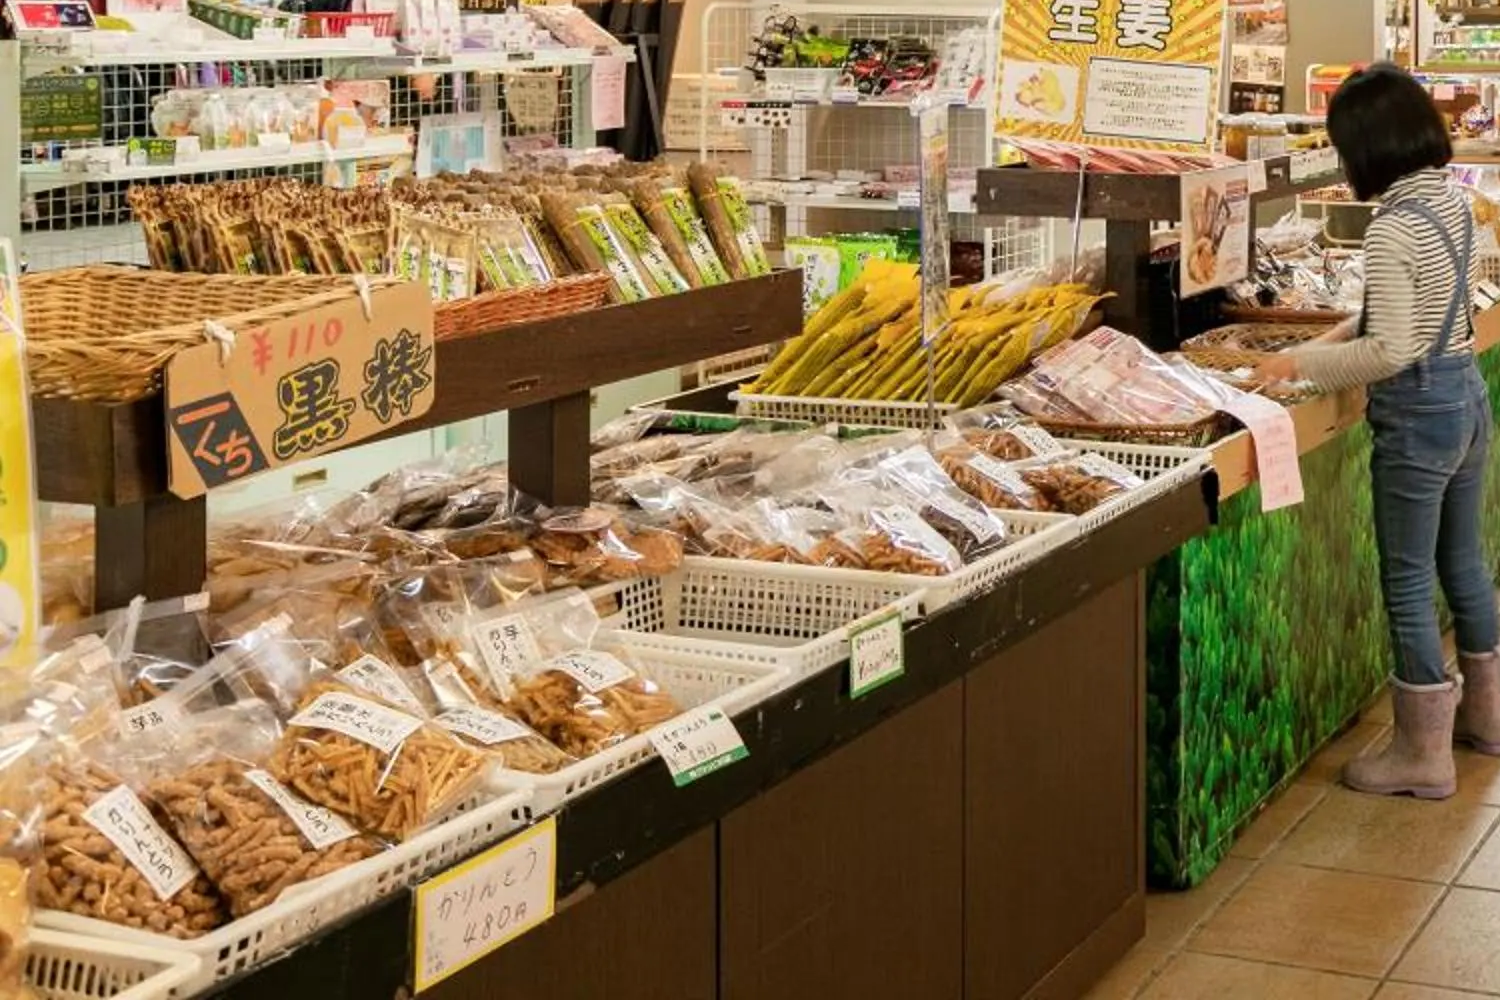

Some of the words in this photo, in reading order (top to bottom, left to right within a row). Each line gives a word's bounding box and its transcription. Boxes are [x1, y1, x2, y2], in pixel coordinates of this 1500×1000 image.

[252, 318, 343, 375] ¥110
[274, 328, 432, 460] 黒棒
[439, 849, 537, 922] かりんとう
[463, 902, 527, 948] 480円
